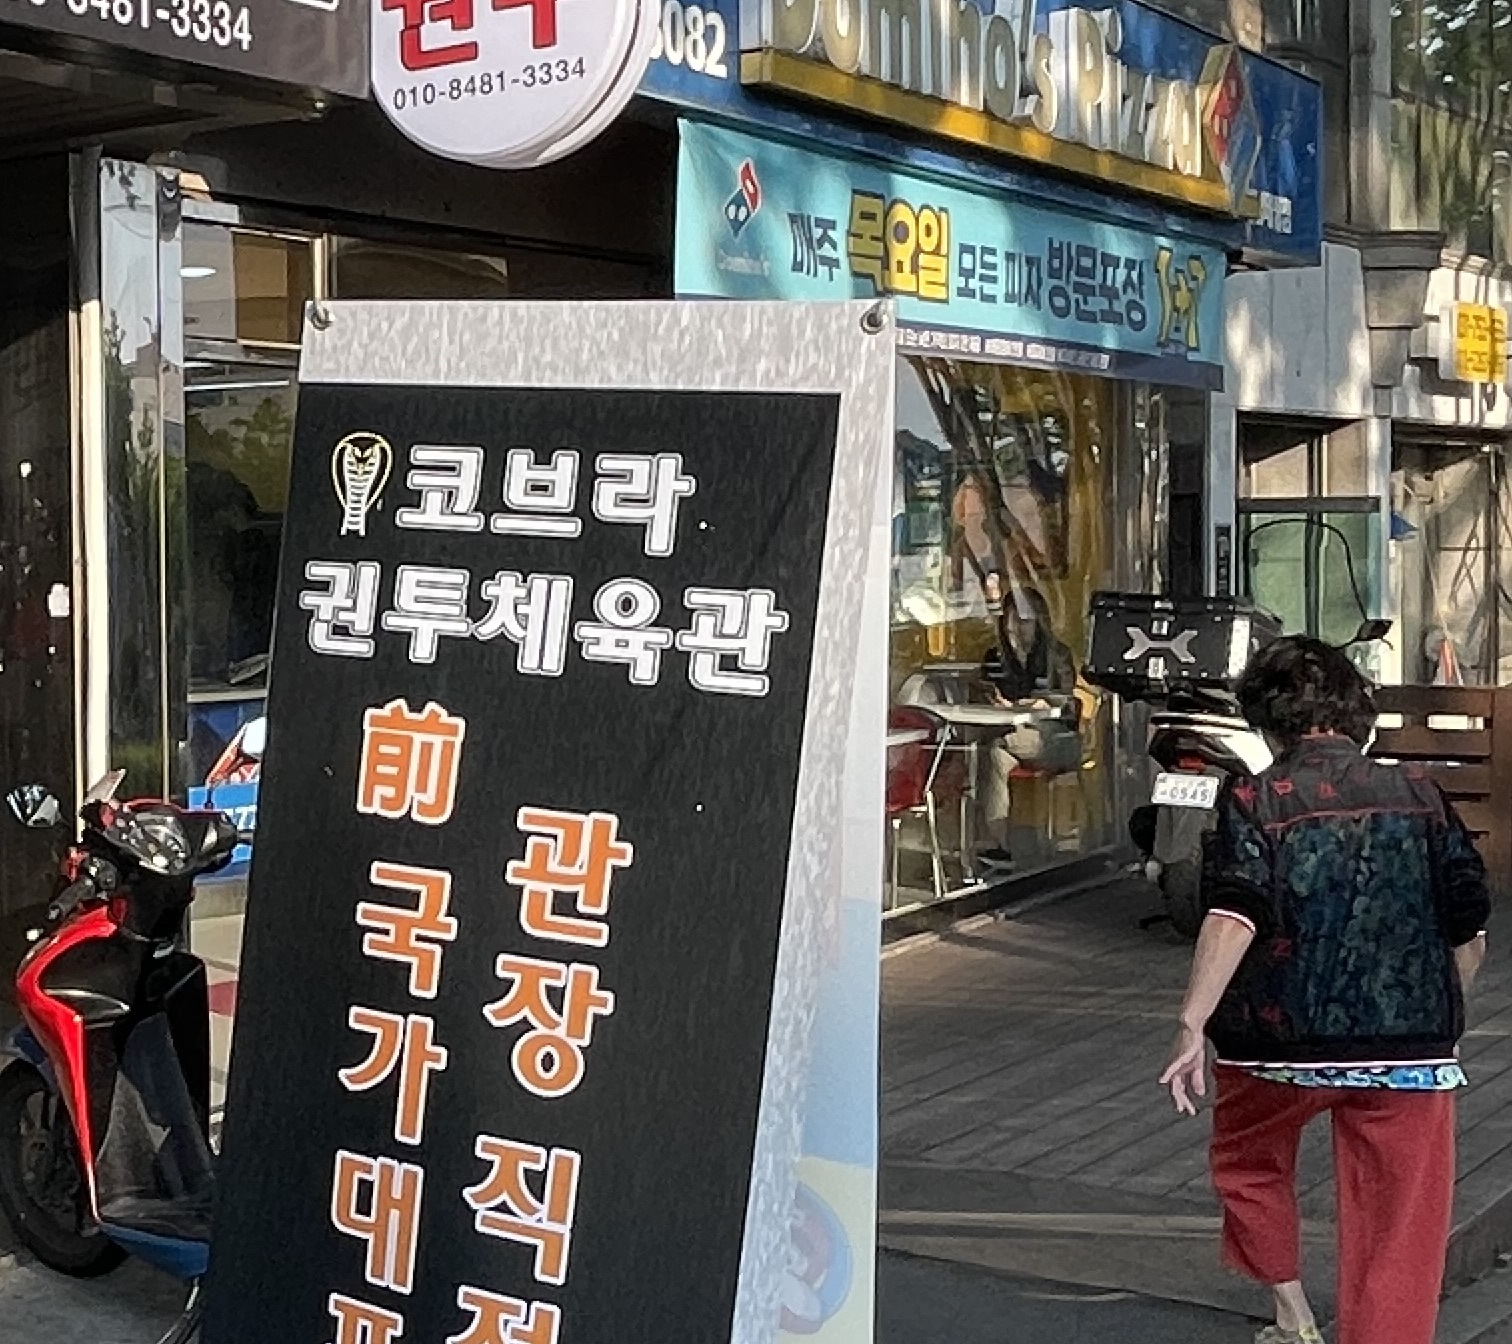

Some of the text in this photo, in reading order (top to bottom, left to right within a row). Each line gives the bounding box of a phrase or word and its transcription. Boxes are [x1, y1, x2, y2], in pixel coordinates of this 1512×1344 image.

[392, 56, 587, 111] 010-8481-3334
[845, 187, 952, 306] 목요일
[955, 241, 999, 305] 모든
[1003, 249, 1044, 313] 피자
[1046, 235, 1148, 323] 방문포장
[395, 443, 698, 558] 코브라
[298, 561, 791, 699] 권투체육관
[356, 699, 467, 826] 前
[482, 805, 635, 1100] 관장
